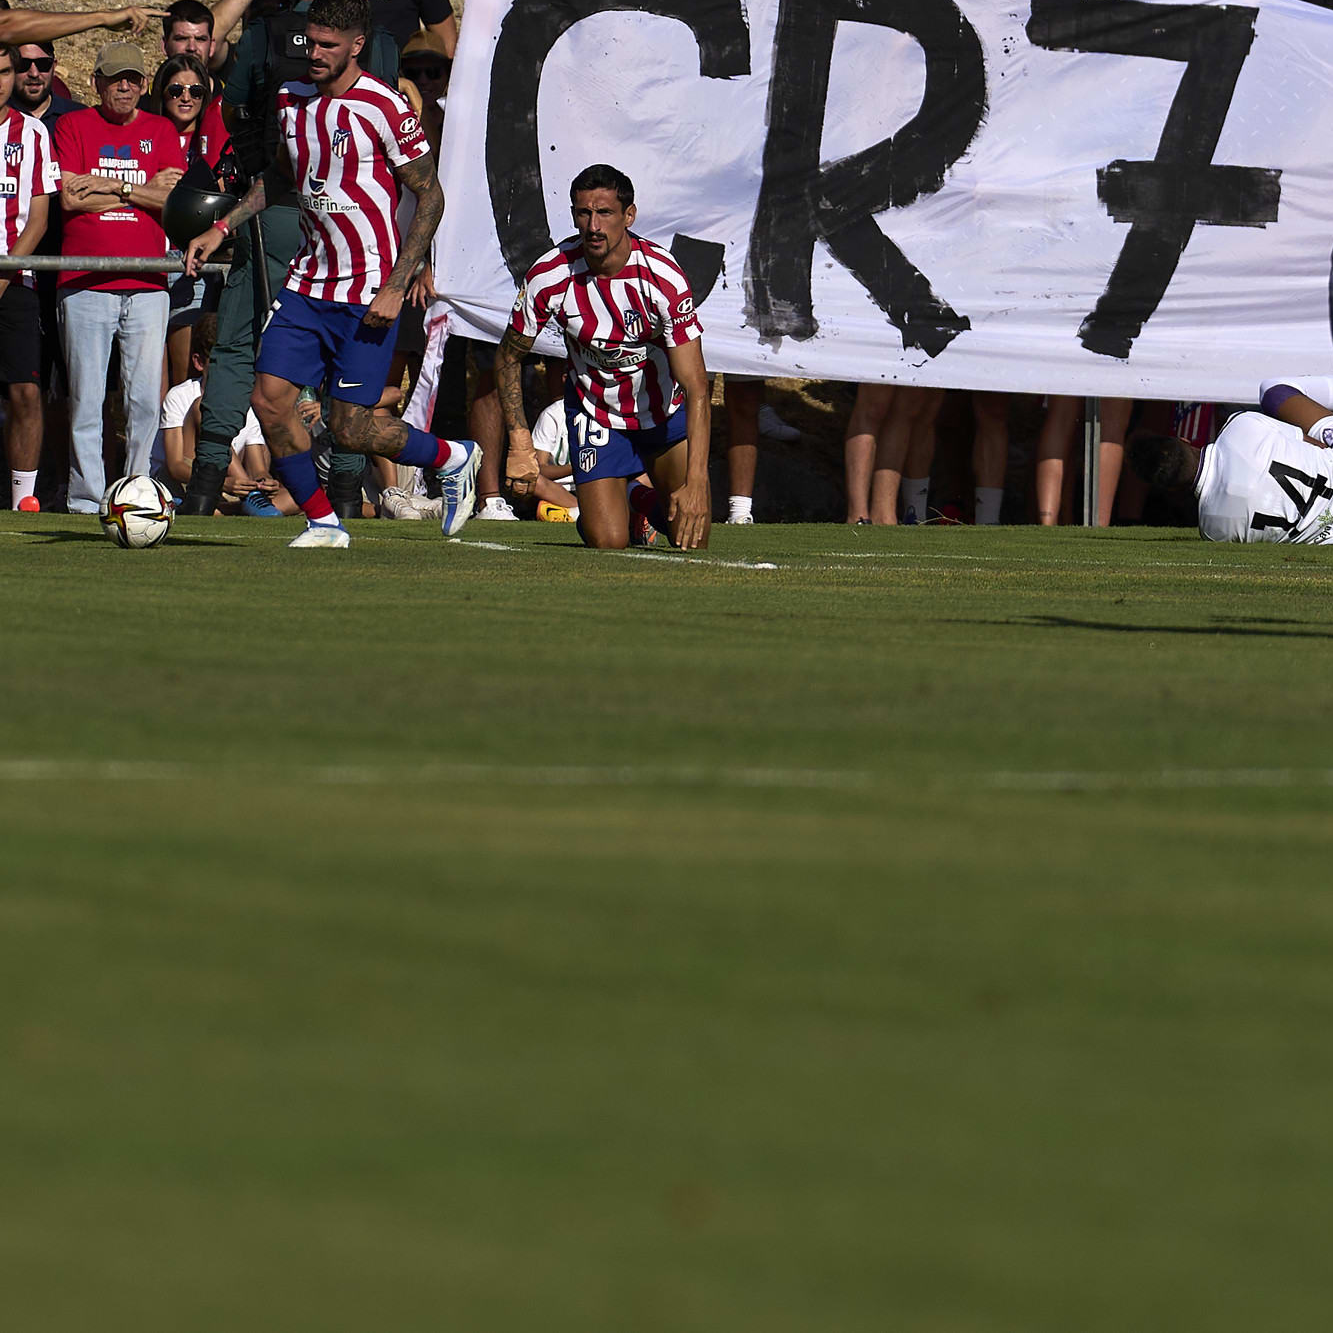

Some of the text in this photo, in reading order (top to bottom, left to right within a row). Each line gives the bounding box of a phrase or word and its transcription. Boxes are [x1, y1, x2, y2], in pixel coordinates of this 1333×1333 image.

[303, 195, 359, 213] aleFin.com
[674, 310, 696, 325] HYUN
[573, 412, 610, 447] 15
